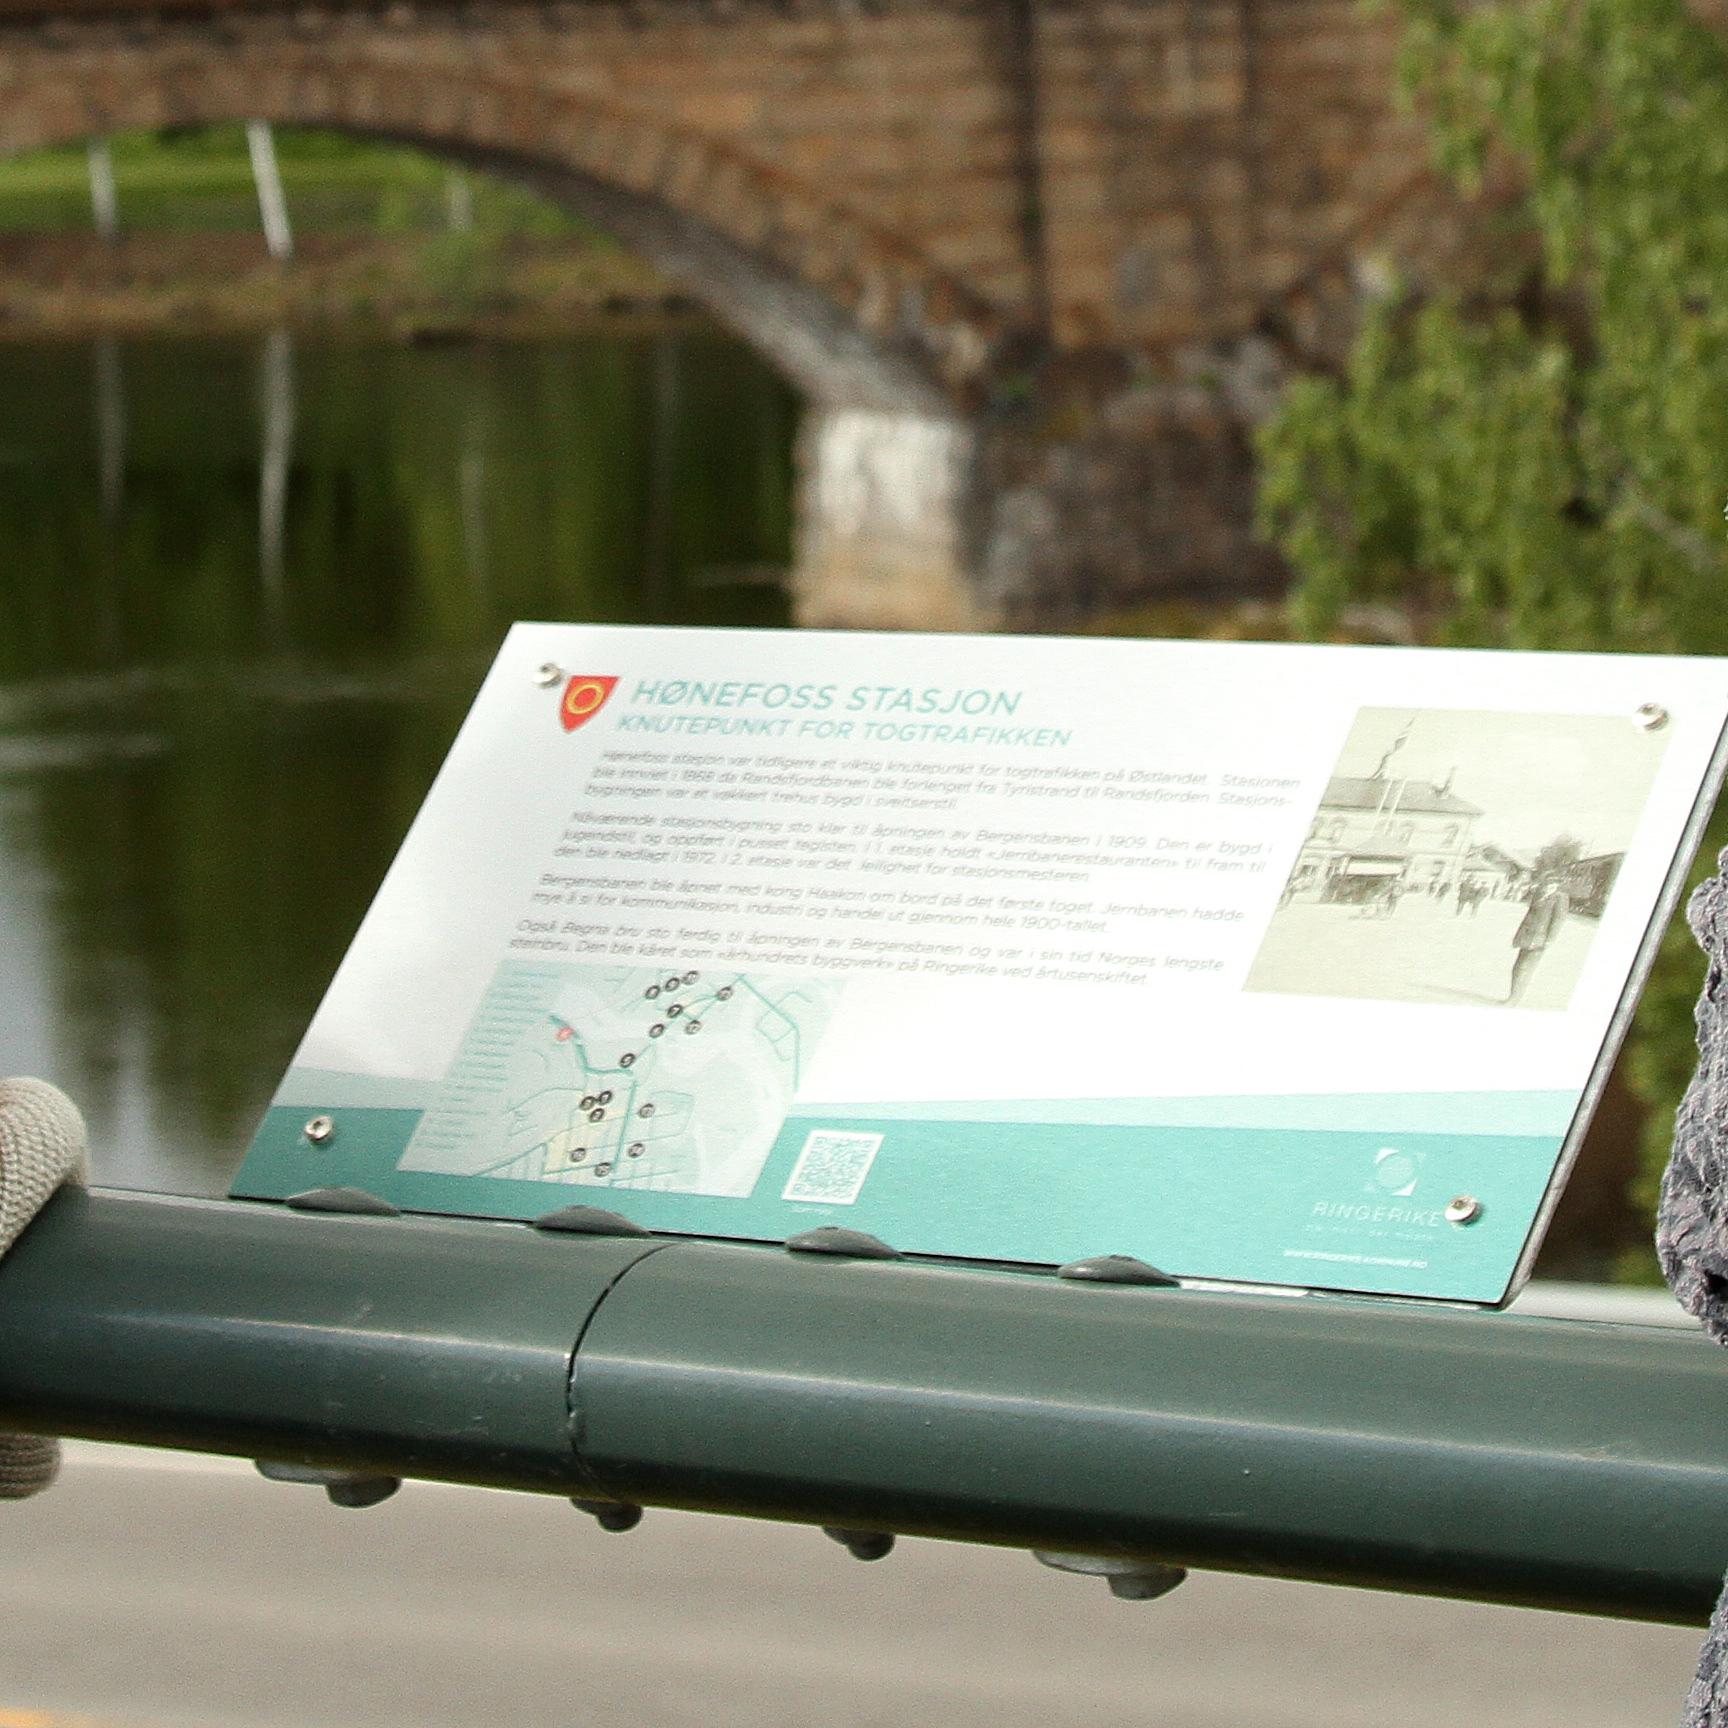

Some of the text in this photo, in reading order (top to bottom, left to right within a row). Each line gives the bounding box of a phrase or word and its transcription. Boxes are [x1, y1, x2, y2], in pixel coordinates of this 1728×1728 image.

[631, 679, 1023, 717] HØNEFOSS STASJON
[617, 714, 1073, 748] KNUTEPUNKT FOR TOGTRAFIKKEN
[1312, 1202, 1442, 1227] RINGERIKE
